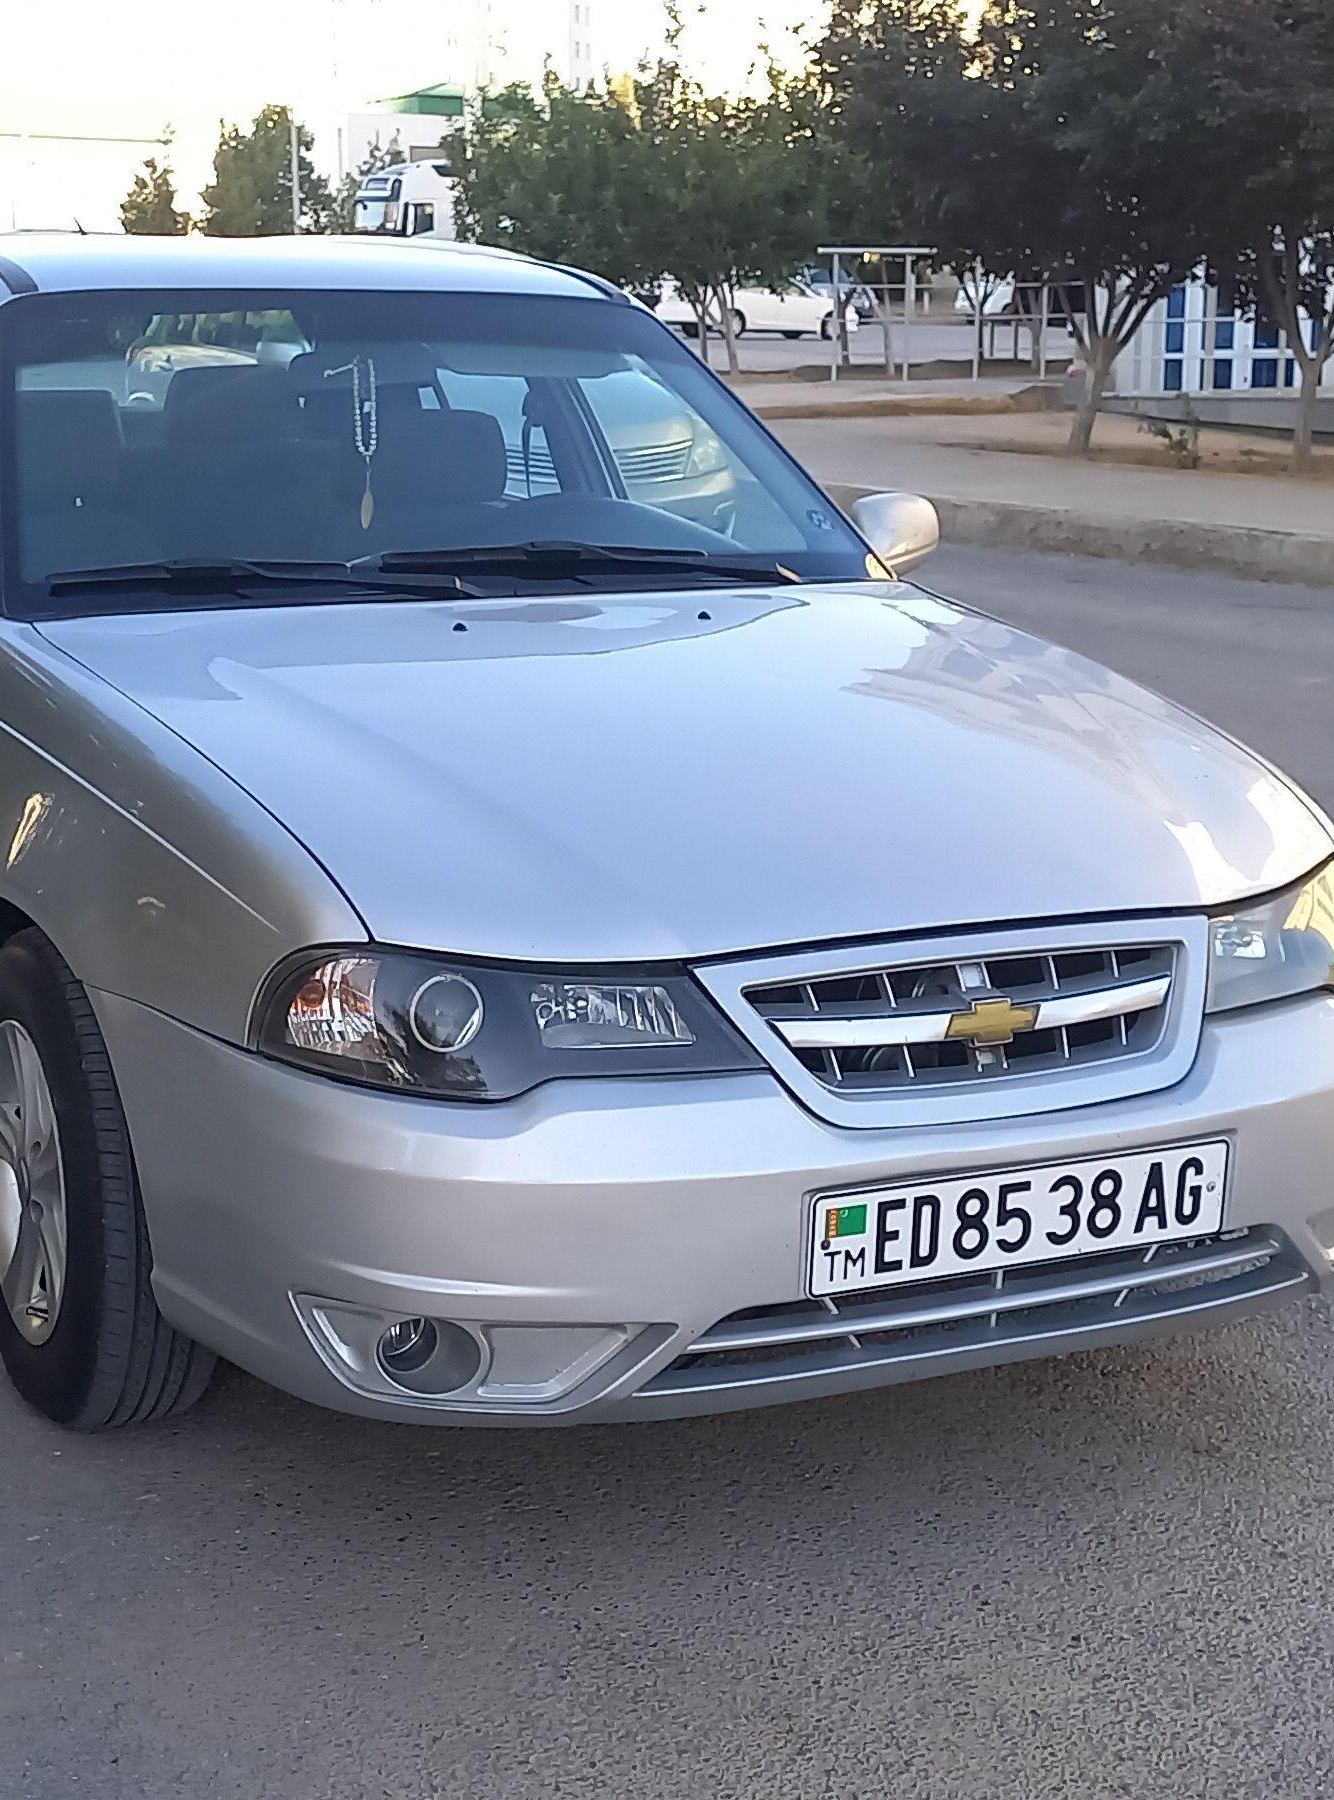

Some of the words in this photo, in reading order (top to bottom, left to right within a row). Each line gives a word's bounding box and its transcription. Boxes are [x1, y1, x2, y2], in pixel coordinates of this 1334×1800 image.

[873, 1194, 941, 1274] ED
[952, 1180, 1033, 1261] 85
[1045, 1168, 1123, 1246] 38
[1133, 1156, 1204, 1234] AG
[823, 1246, 866, 1283] TM
